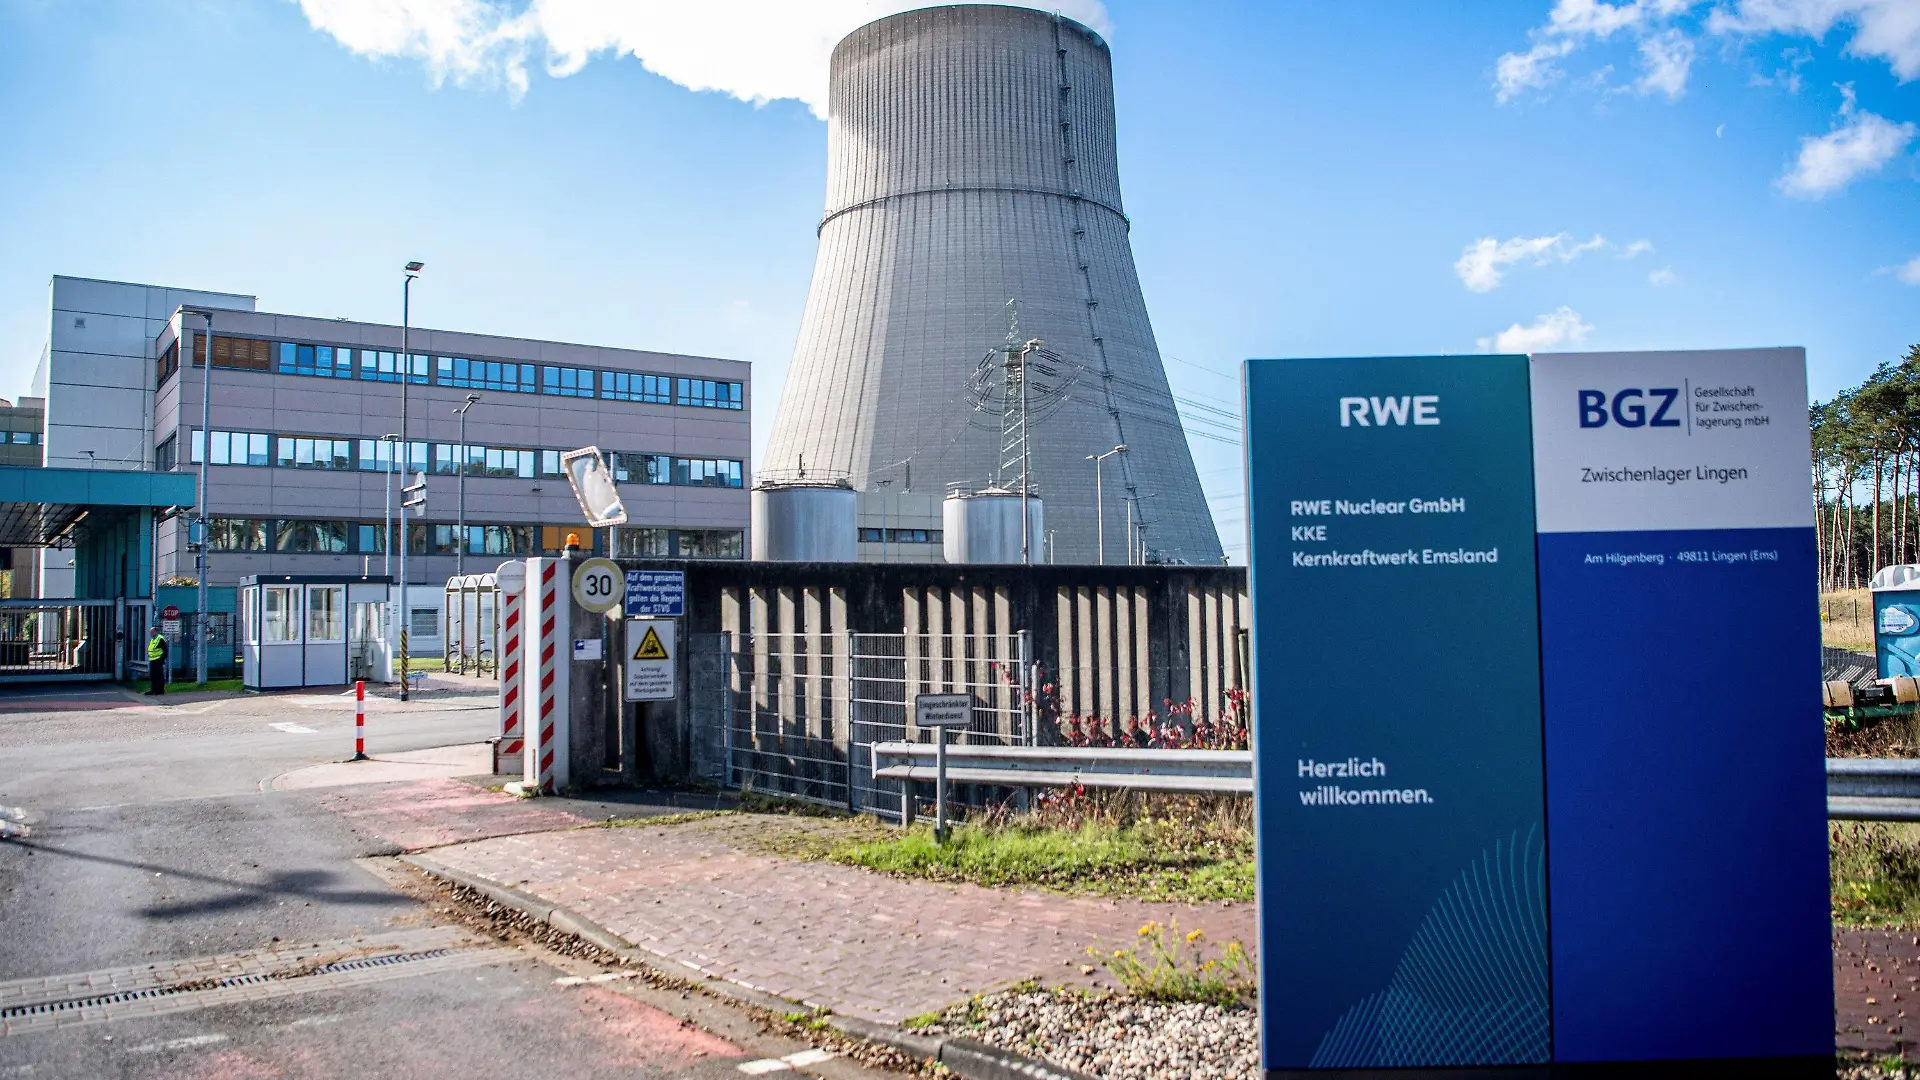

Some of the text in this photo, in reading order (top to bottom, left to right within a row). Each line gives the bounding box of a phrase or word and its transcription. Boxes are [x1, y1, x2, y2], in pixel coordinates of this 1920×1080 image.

[1694, 385, 1755, 398] Gesellschaft
[1339, 395, 1441, 427] RWE
[1577, 388, 1681, 429] BGZ
[1695, 400, 1764, 412] für Zwischen-
[1696, 415, 1770, 430] lagerung mbH
[1580, 466, 1748, 485] Zwischenlager Lingen
[1291, 497, 1466, 516] RWE Nuclear GmbH
[1291, 525, 1327, 541] KKE
[1292, 548, 1498, 567] Kernkraftwerk Emsland
[1584, 553, 1603, 564] Am
[1606, 552, 1664, 566] Hilgenberg
[1677, 551, 1709, 562] 49811
[1712, 551, 1747, 564] Lingen
[1750, 550, 1778, 562] (Ems)
[586, 574, 612, 596] 30
[627, 572, 682, 583] Auf dem gesamten
[629, 594, 681, 604] gelten die Regeln
[640, 604, 651, 613] der
[919, 699, 968, 710] Eingeschränkter
[1298, 757, 1386, 778] Herzlich
[1299, 785, 1434, 806] willkommen.
